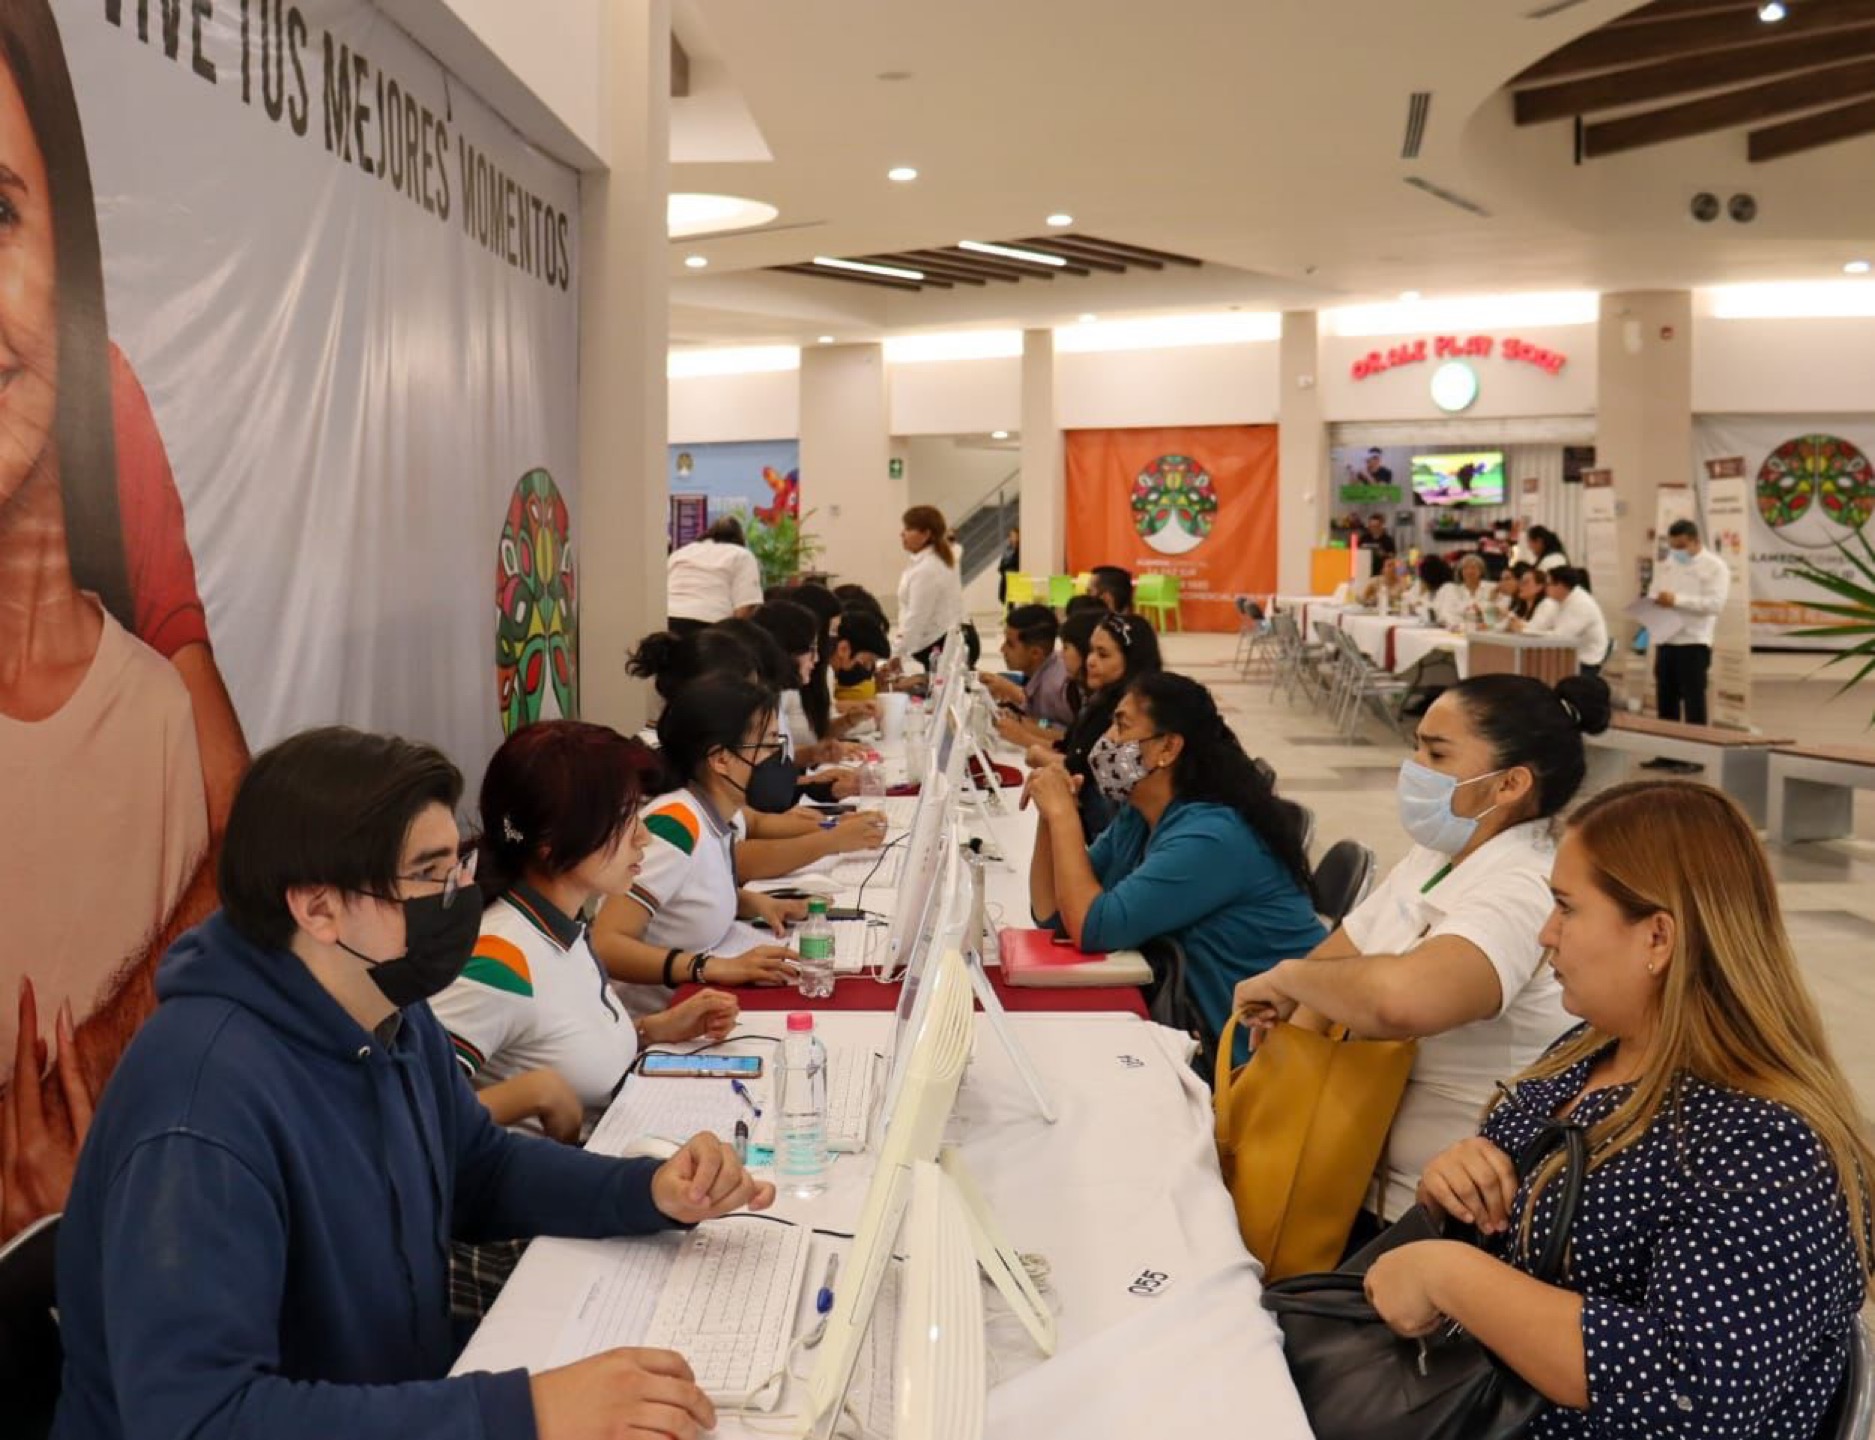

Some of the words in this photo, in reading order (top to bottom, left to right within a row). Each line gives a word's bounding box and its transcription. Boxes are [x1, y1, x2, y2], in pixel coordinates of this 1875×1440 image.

[240, 0, 308, 136] TUS
[323, 30, 449, 222] MEJORES
[1127, 1268, 1169, 1294] 055
